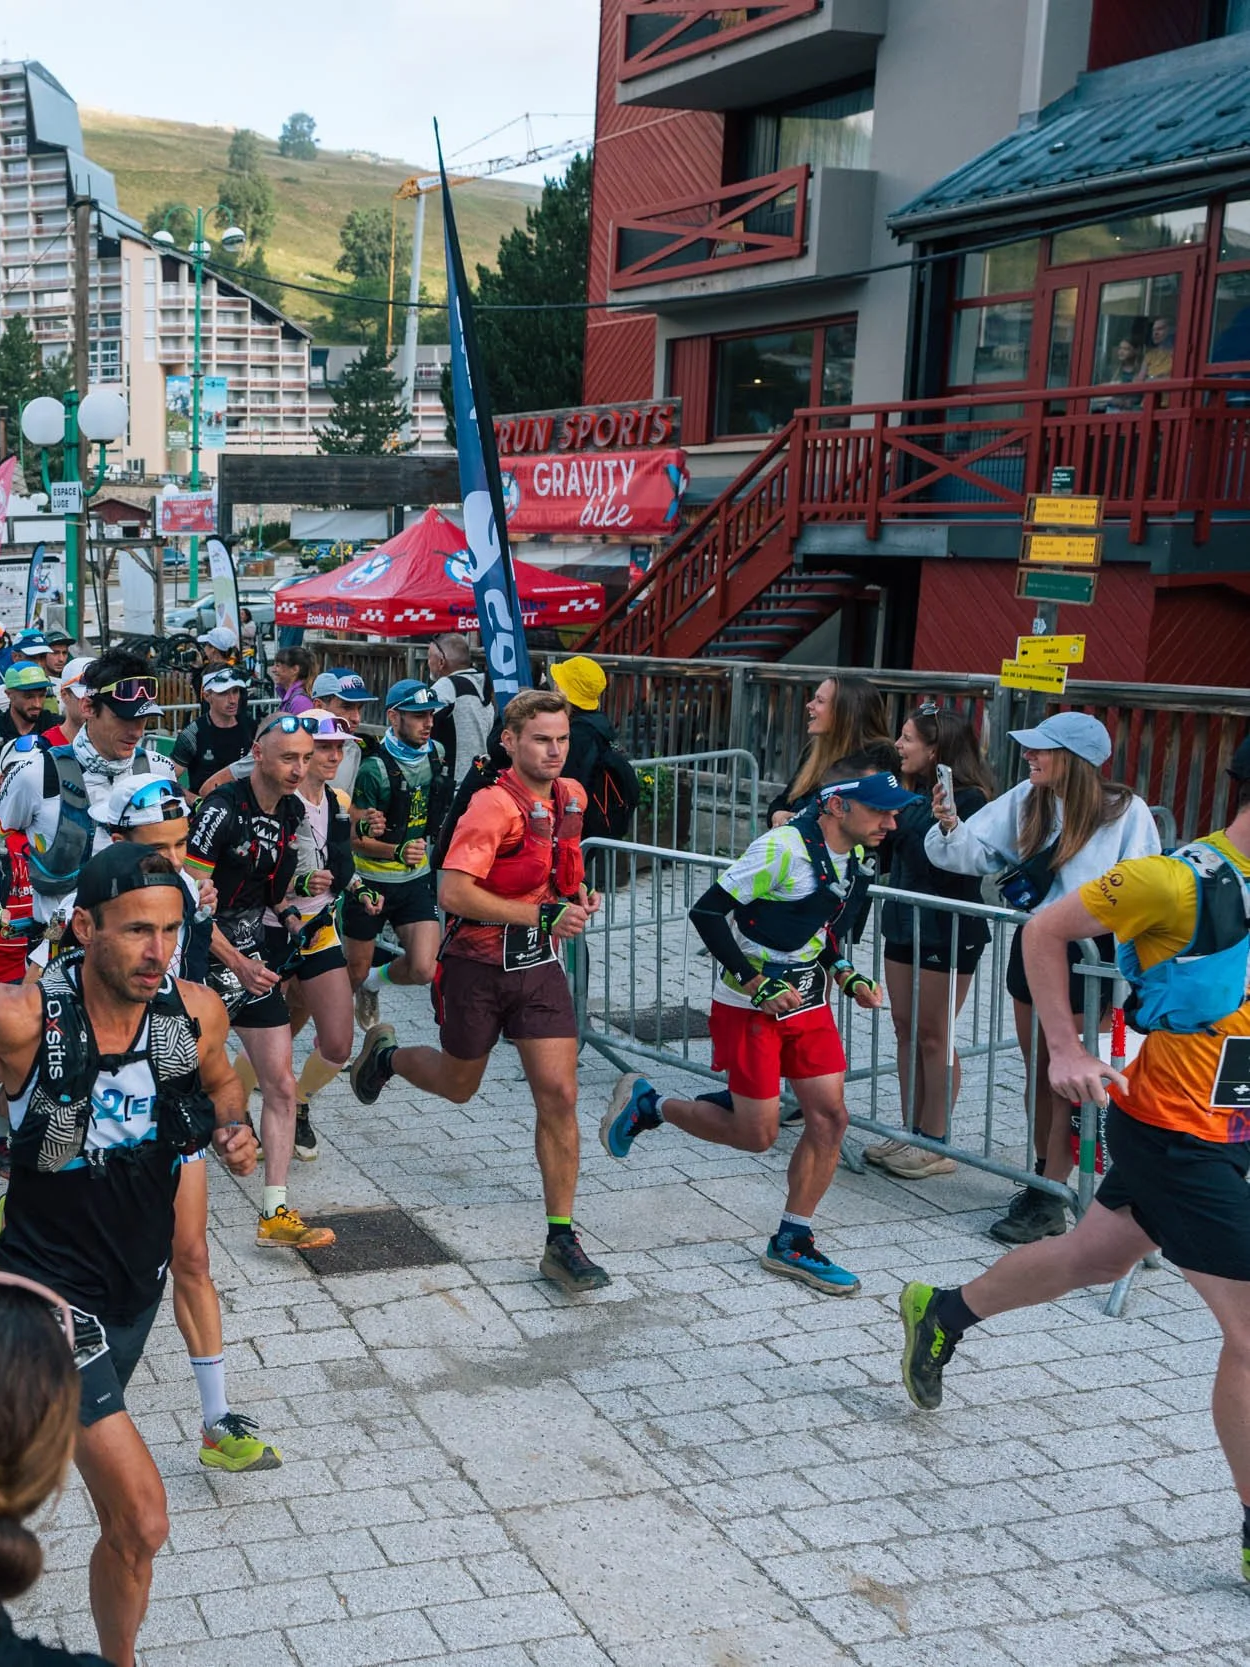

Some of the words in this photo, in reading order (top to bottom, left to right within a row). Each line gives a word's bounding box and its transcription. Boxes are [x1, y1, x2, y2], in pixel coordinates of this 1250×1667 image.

[558, 404, 674, 449] SPORTS
[533, 459, 636, 497] GRAVITY
[53, 486, 78, 497] ESPACE
[53, 498, 70, 509] LUGE
[579, 487, 633, 527] bike
[307, 612, 325, 626] Ecole
[326, 613, 335, 627] de
[336, 615, 349, 629] VTT
[798, 978, 813, 991] 28
